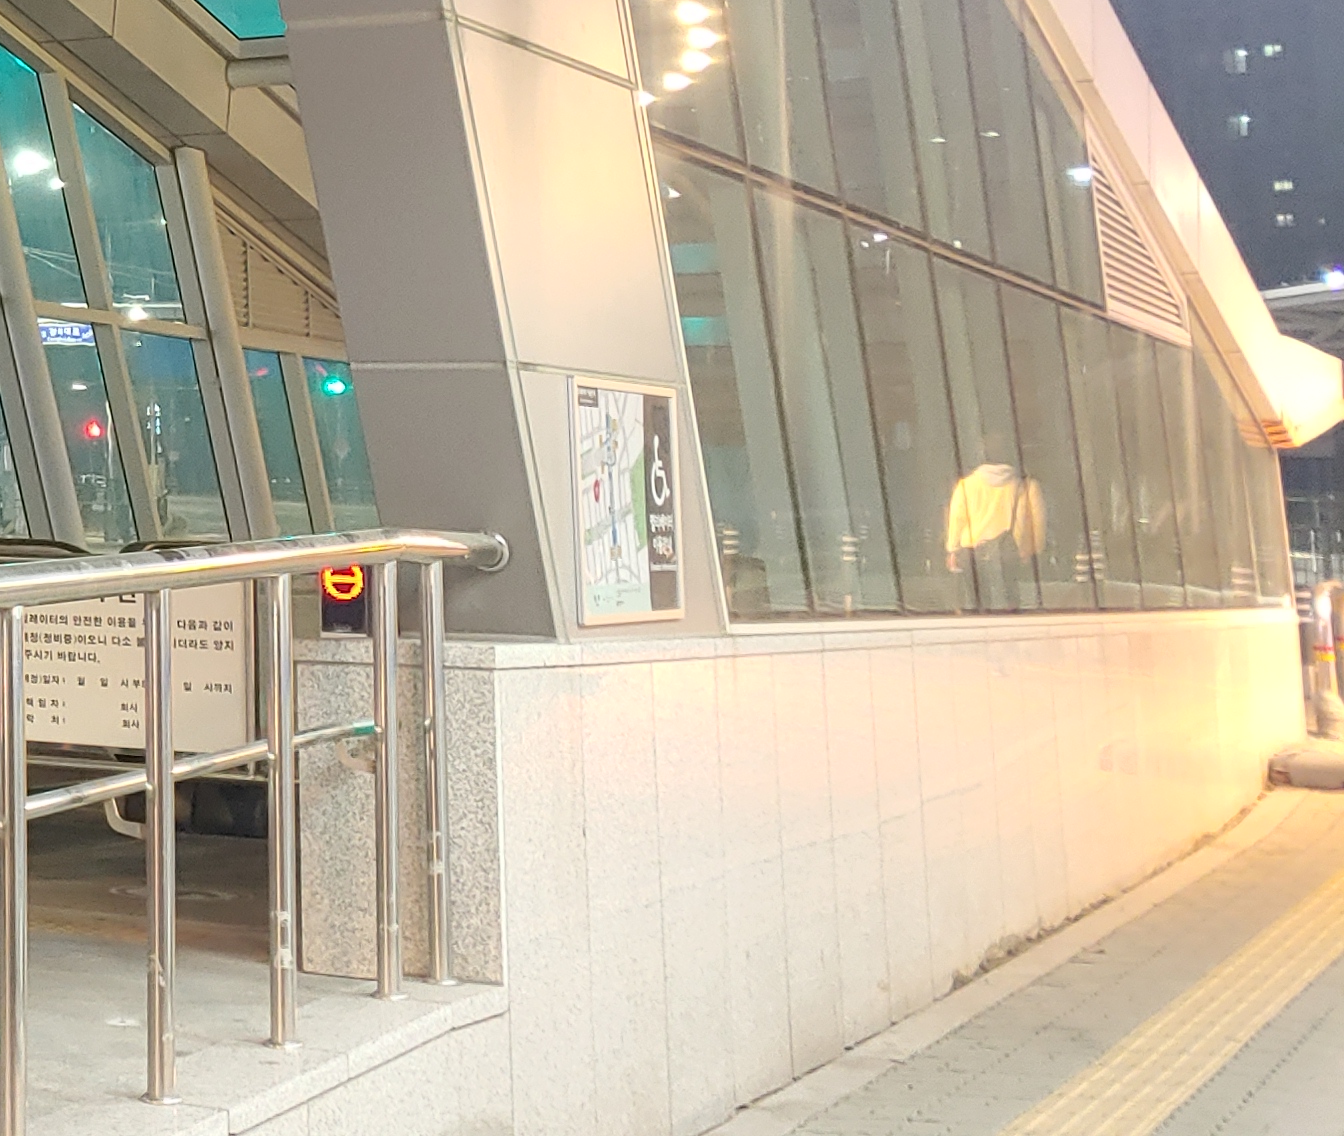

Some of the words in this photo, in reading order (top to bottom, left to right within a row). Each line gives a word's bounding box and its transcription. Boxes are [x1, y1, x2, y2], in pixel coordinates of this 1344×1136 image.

[73, 615, 103, 627] 안전한
[107, 616, 137, 629] 이용을
[176, 619, 208, 632] 다음과
[212, 620, 234, 633] 같이
[111, 636, 132, 648] 다소
[213, 640, 235, 652] 양지
[57, 650, 101, 664] 바랍니다.
